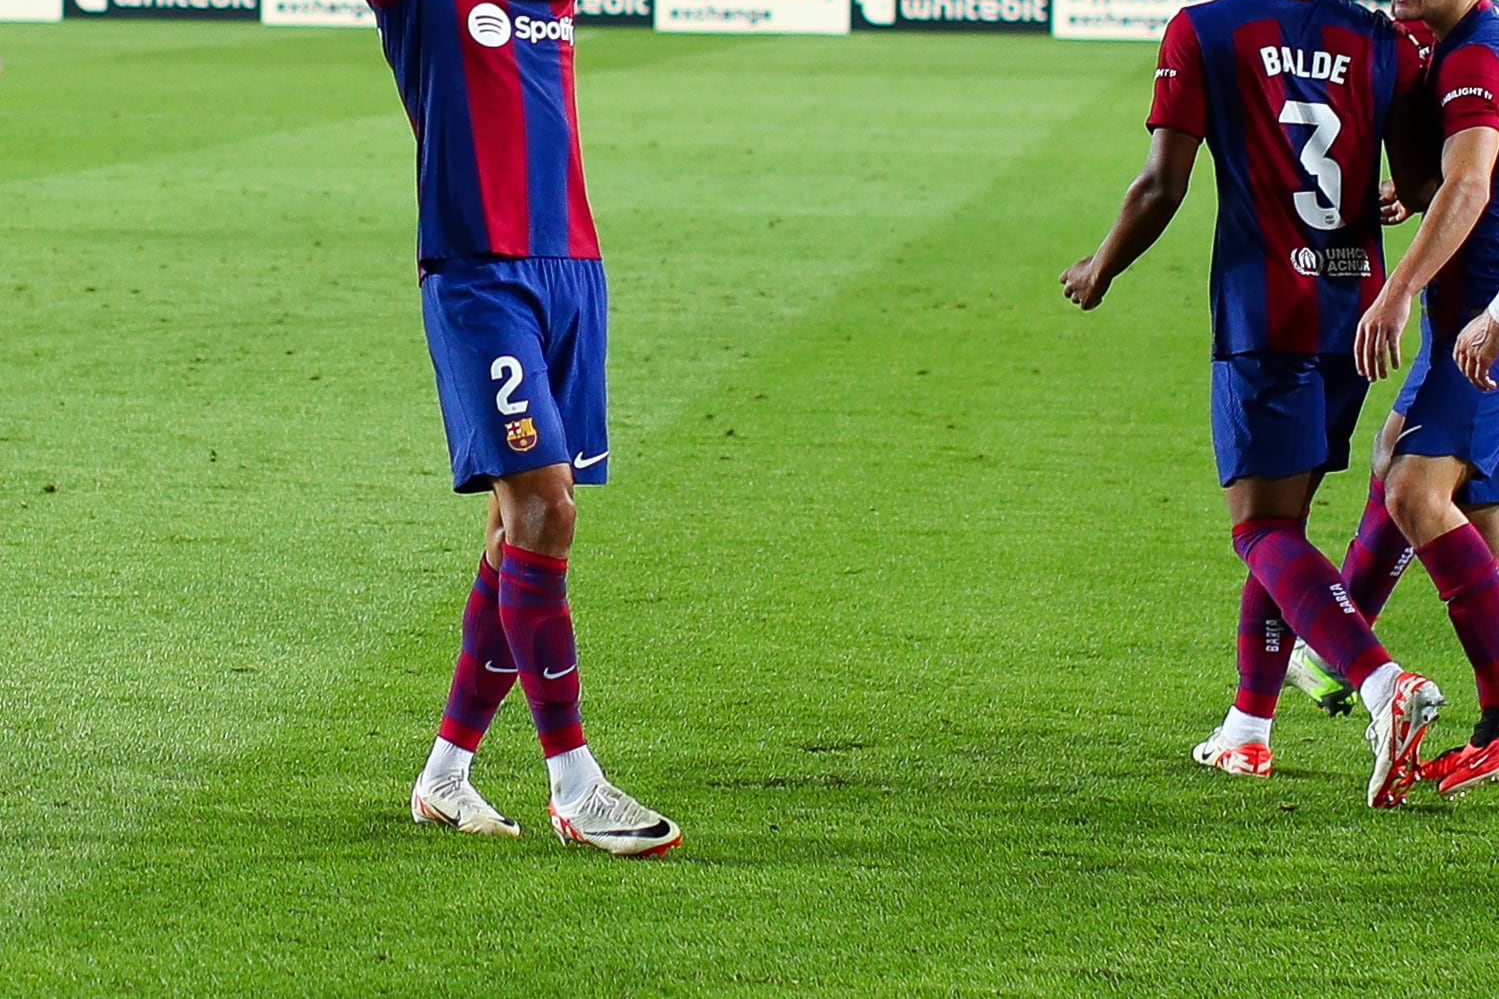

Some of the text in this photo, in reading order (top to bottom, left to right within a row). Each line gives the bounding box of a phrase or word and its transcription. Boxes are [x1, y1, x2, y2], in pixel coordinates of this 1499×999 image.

[671, 4, 772, 24] exchange
[1259, 45, 1351, 85] BALDE
[1278, 99, 1347, 231] 3
[490, 356, 529, 415] 2
